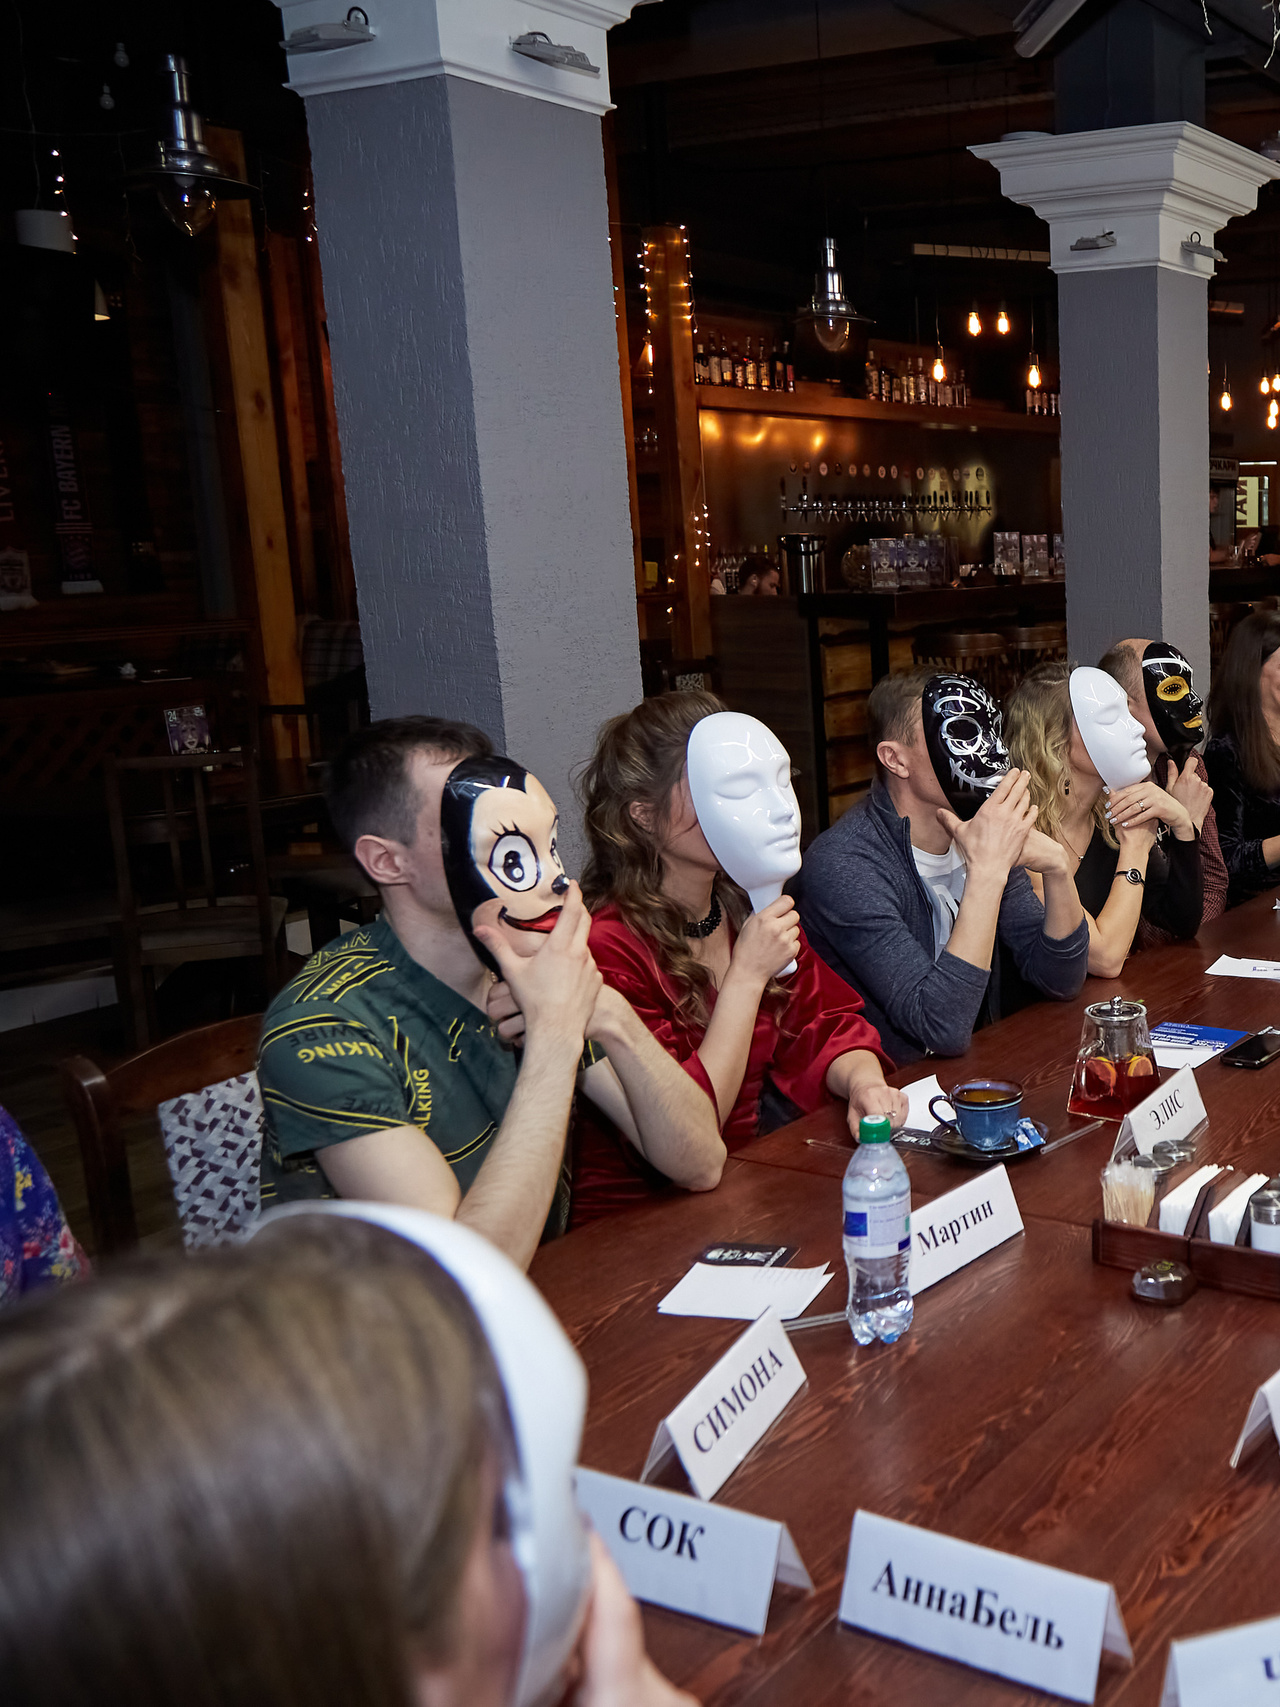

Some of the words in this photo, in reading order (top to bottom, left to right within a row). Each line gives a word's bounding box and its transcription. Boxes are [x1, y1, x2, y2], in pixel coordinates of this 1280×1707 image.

[49, 424, 80, 493] BAYERN
[167, 711, 177, 722] 24
[1149, 1089, 1185, 1131] ЭЛИС
[916, 1199, 994, 1256] Мартин
[693, 1347, 784, 1454] СИМОНА
[619, 1505, 706, 1561] СОК
[872, 1560, 1064, 1650] АннаБель
